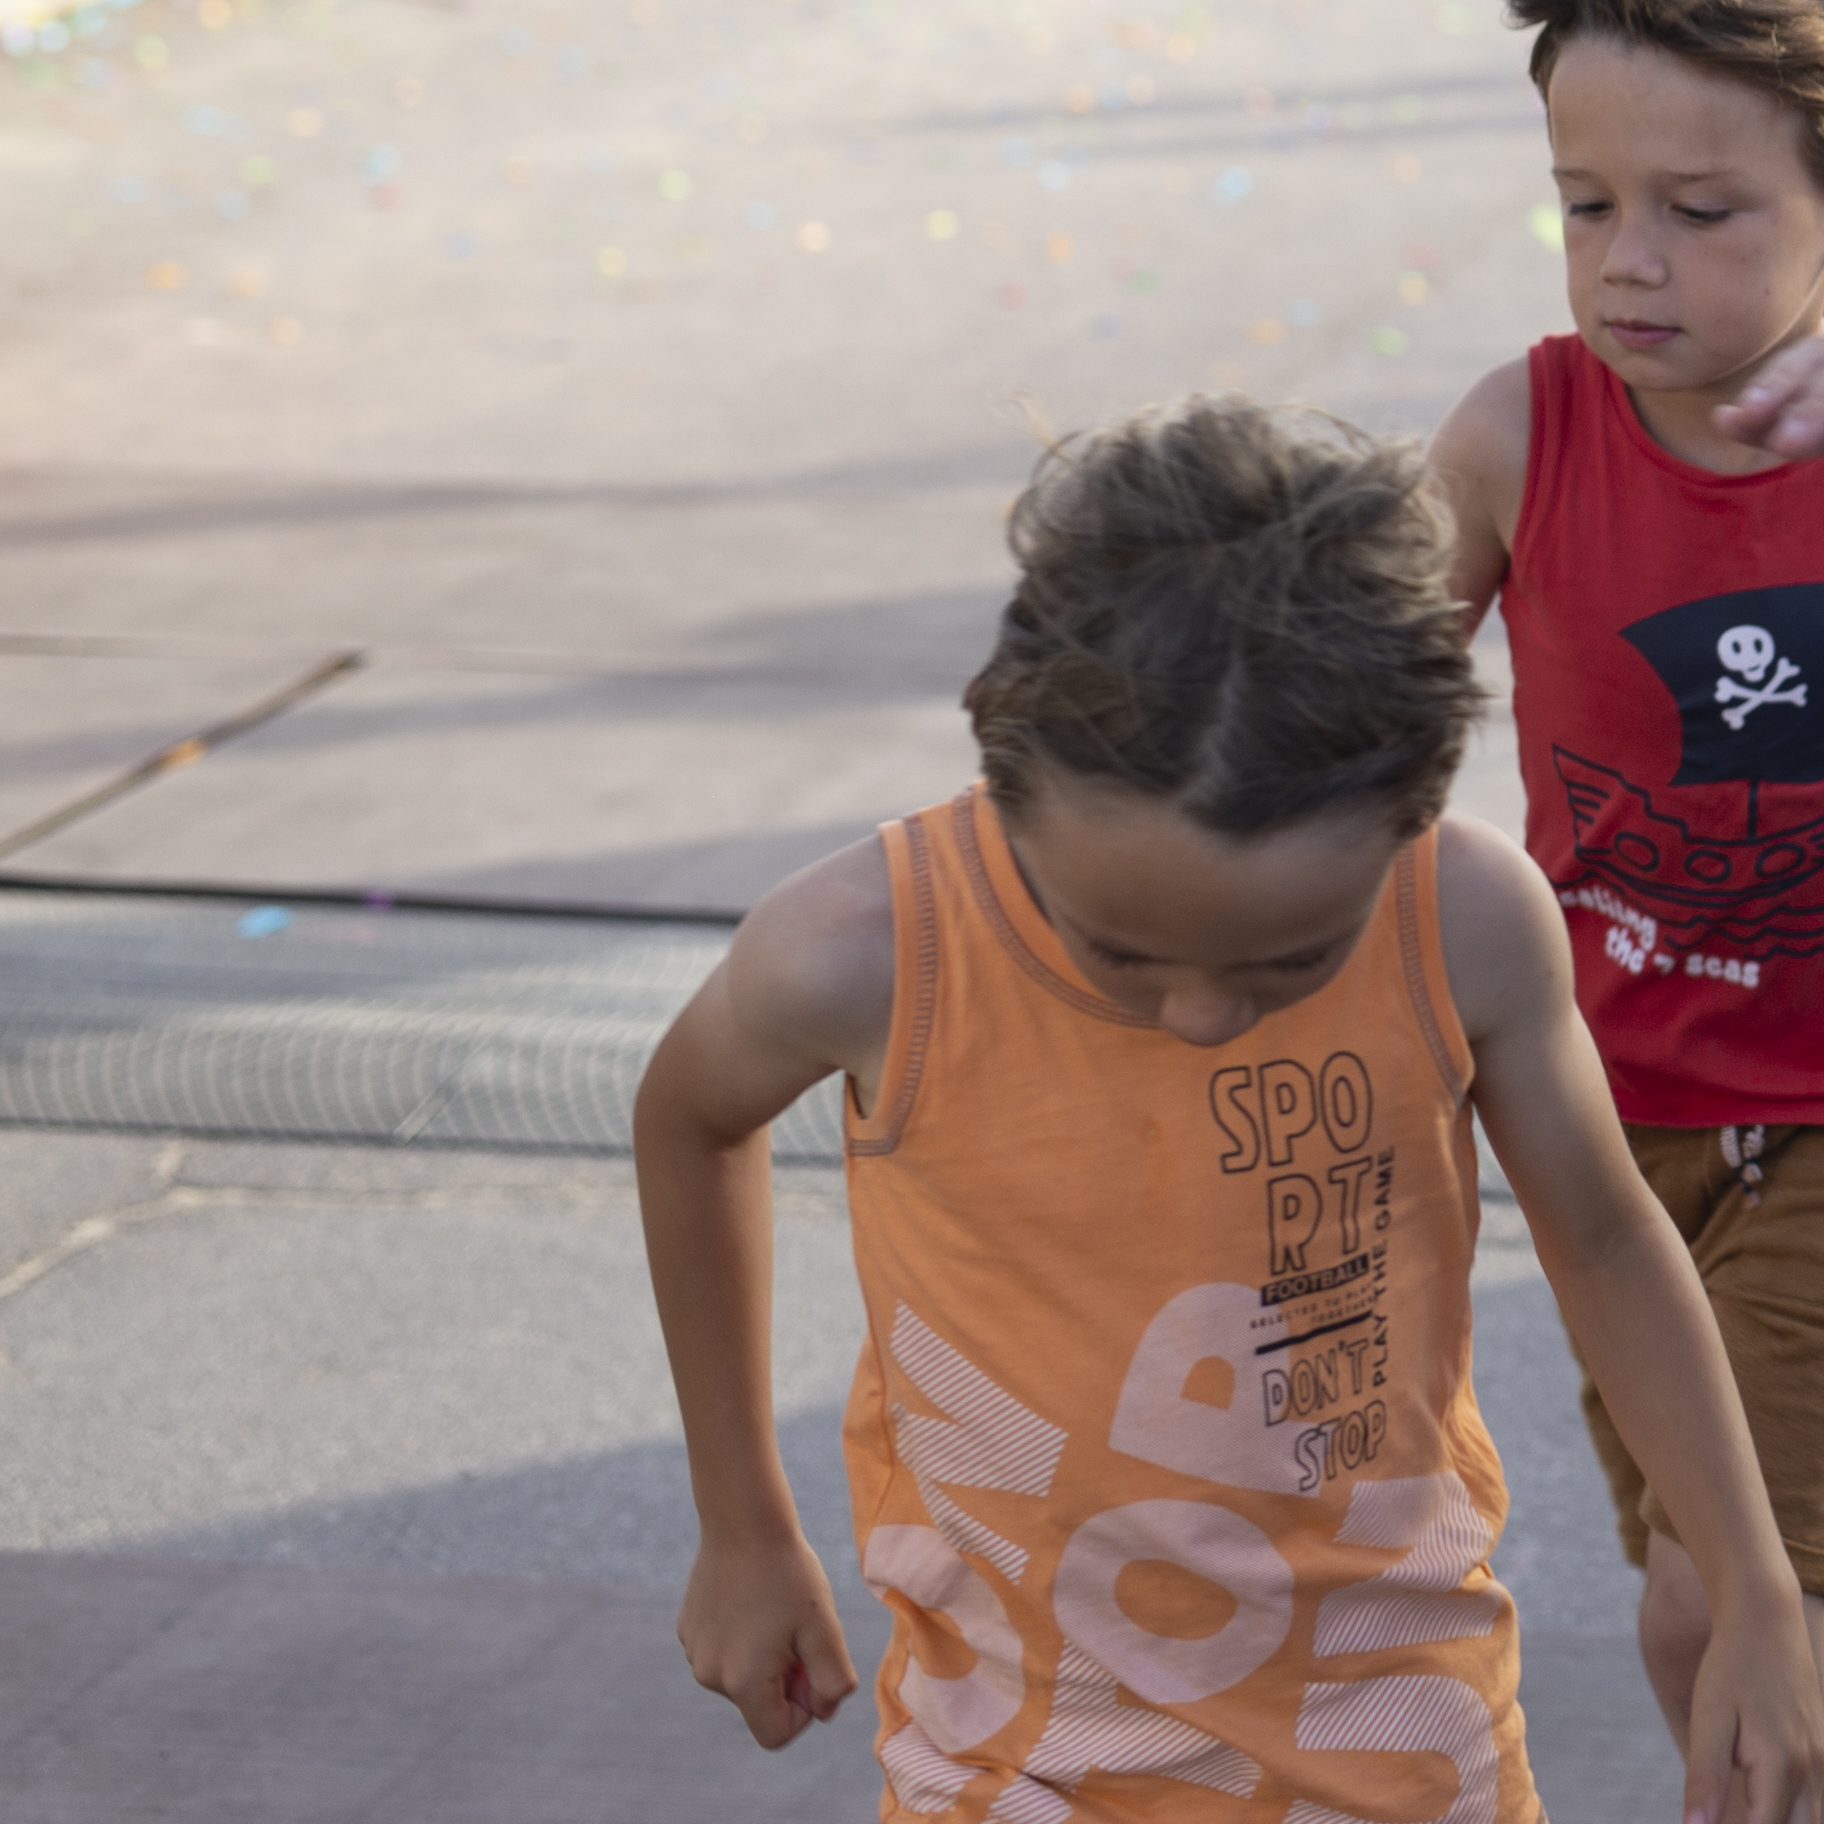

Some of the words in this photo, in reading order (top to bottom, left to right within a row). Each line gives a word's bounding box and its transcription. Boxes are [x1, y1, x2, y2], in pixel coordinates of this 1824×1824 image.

[1685, 952, 1760, 990] seas
[1209, 1049, 1373, 1174] SPO
[1267, 1154, 1373, 1276] RT
[1374, 1146, 1396, 1231] GAME
[1265, 1253, 1368, 1304] FOOTBALL
[1371, 1239, 1388, 1304] THE
[1263, 1337, 1369, 1427] DON'T
[1372, 1313, 1389, 1388] PLAY
[1295, 1399, 1387, 1492] STOP
